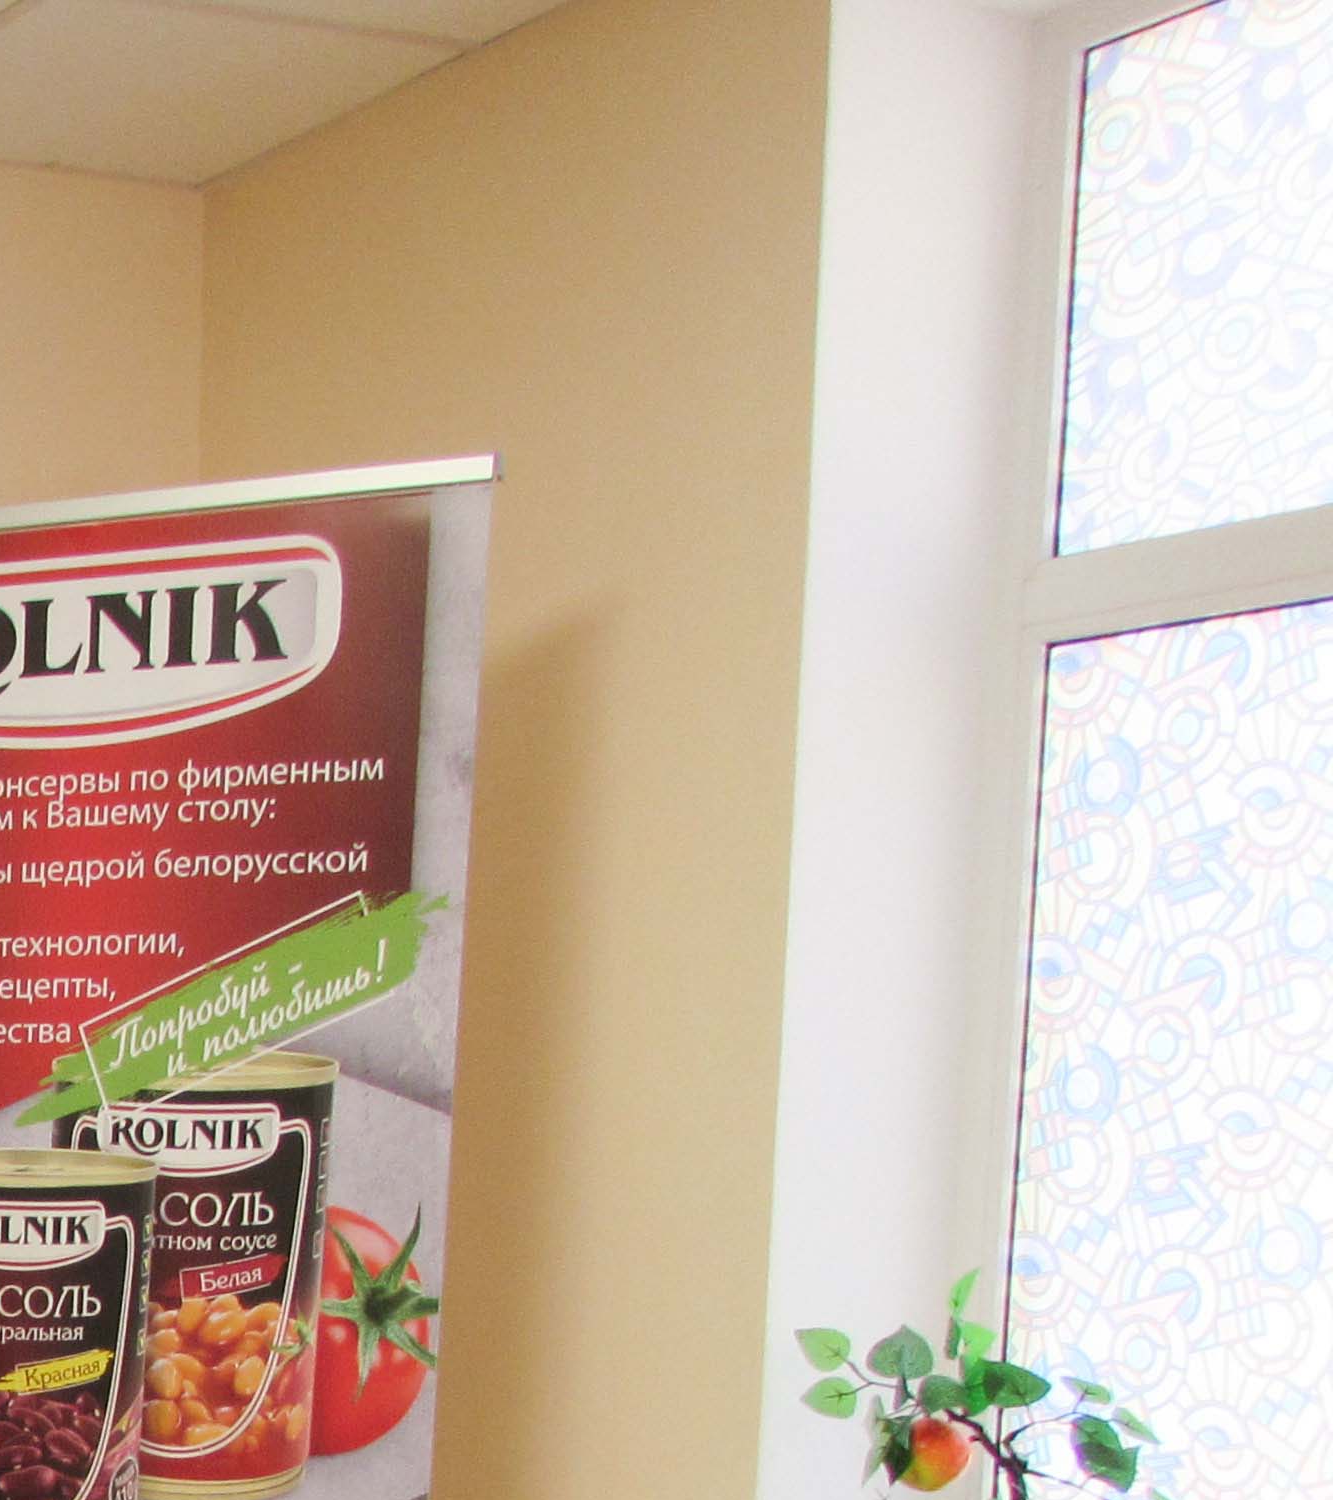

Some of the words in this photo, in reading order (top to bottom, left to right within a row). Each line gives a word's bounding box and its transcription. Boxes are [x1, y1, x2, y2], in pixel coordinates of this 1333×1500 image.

[130, 767, 169, 792] по
[177, 755, 386, 796] фирменным
[22, 808, 39, 830] к
[46, 799, 171, 839] Вашему
[176, 796, 277, 833] столу:
[20, 850, 146, 892] щедрой
[153, 841, 370, 889] белорусской
[108, 961, 270, 1071] Попробуй
[167, 1052, 189, 1078] и
[201, 938, 388, 1066] полюбишь!
[110, 1115, 264, 1157] ROLNIK
[155, 1190, 275, 1228] СОЛЬ
[220, 1232, 277, 1255] соусе
[199, 1265, 262, 1293] Белая
[24, 1358, 101, 1390] Красная
